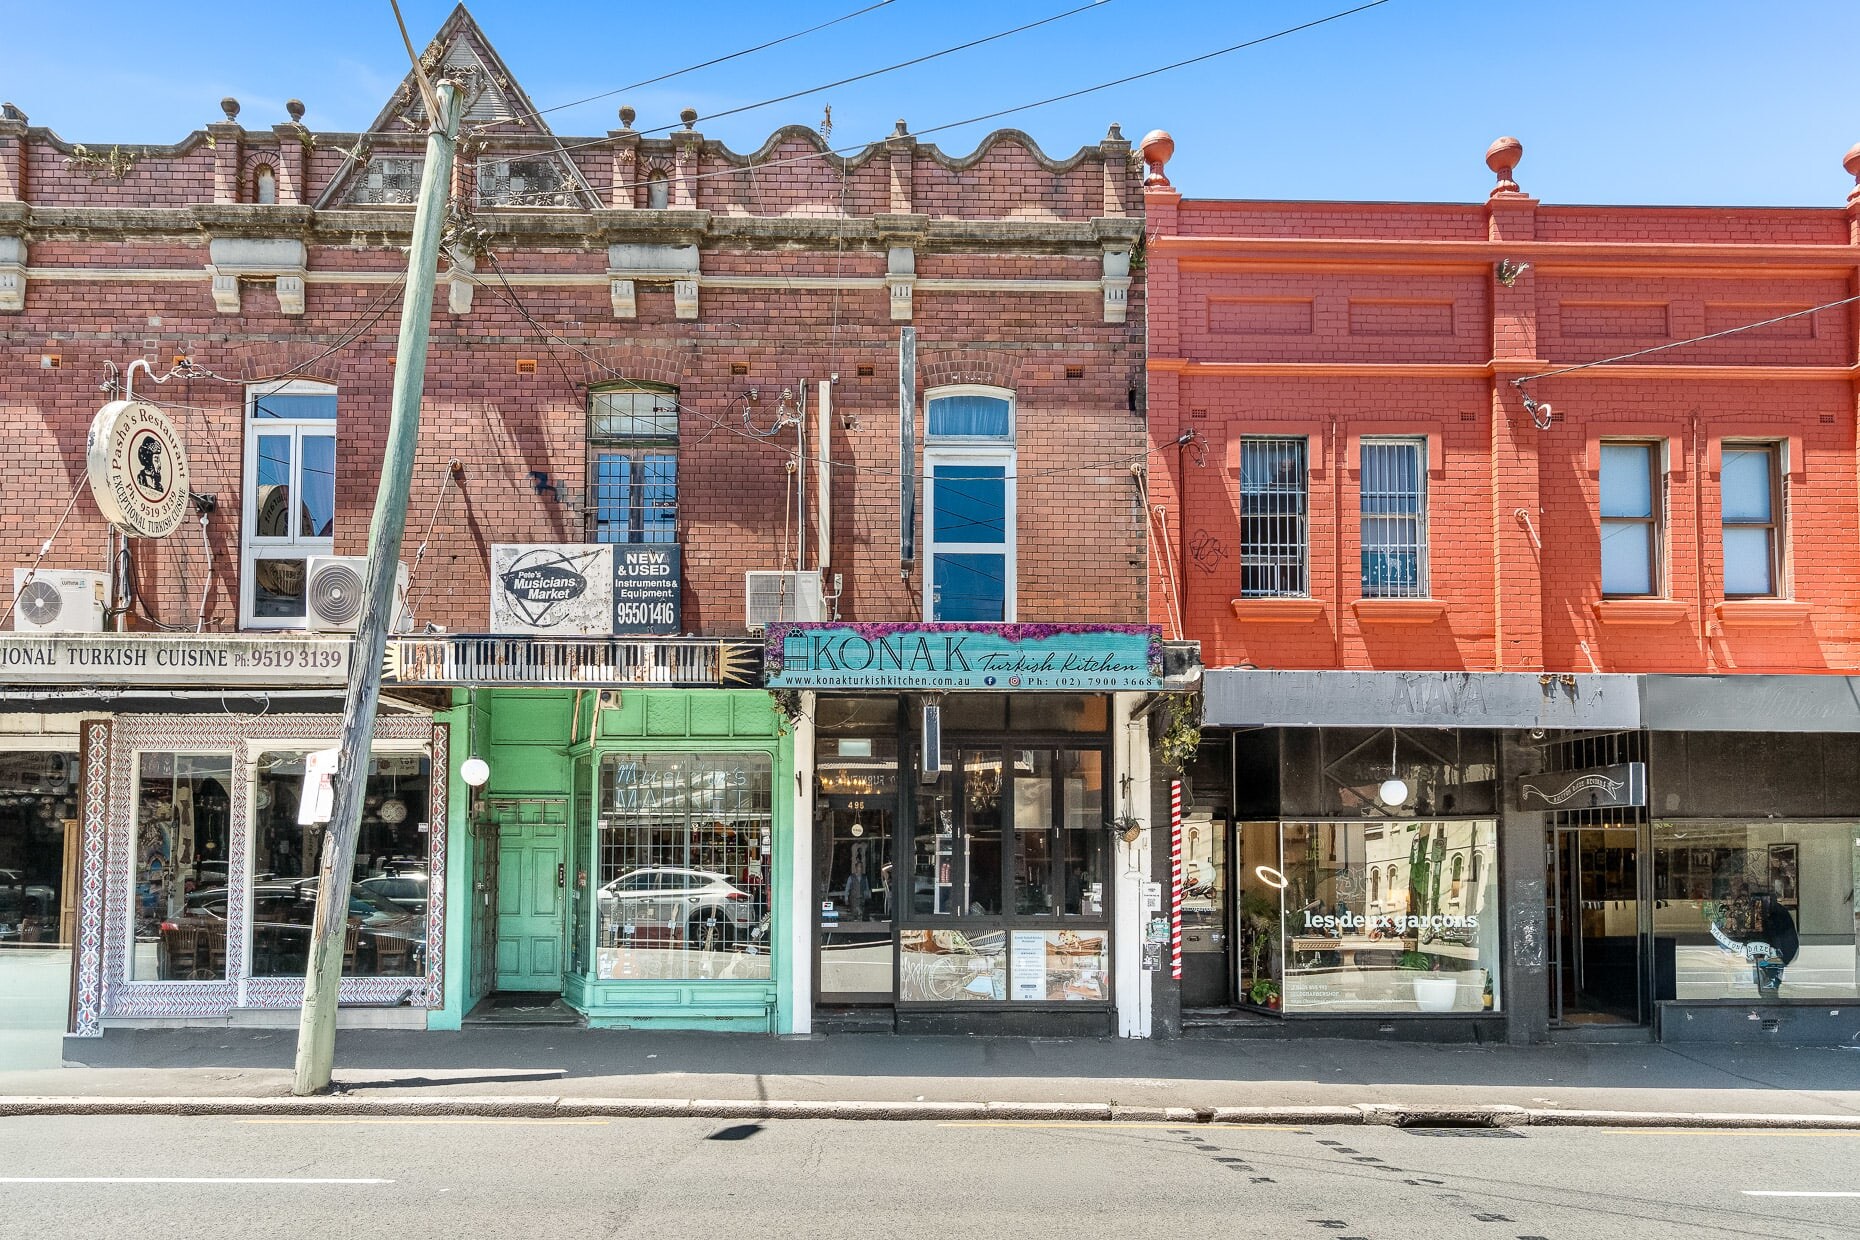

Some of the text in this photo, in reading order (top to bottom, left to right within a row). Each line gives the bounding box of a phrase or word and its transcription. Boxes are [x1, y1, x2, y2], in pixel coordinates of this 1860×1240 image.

[112, 408, 186, 479] Pasha's Restaurant
[112, 474, 187, 534] EXCEPTIONAL TURKISH CUISINE
[140, 502, 160, 518] 9519
[162, 490, 177, 515] 3139
[626, 553, 665, 564] NEW
[513, 576, 576, 590] Musicians
[518, 571, 542, 579] Pete's
[527, 588, 570, 600] Market
[68, 648, 147, 666] TURKISH
[156, 649, 229, 667] CUISINE
[234, 652, 250, 667] Ph:
[251, 650, 295, 668] 9519
[298, 650, 342, 668] 3139
[811, 635, 972, 671] KONAK
[977, 651, 1139, 673] Turkish Kitchen
[785, 674, 971, 687] www.konakturkishkitchen.com.au
[1027, 676, 1153, 687] Ph: (02) 7900 3668
[1304, 911, 1335, 928] les
[1341, 911, 1392, 928] deux
